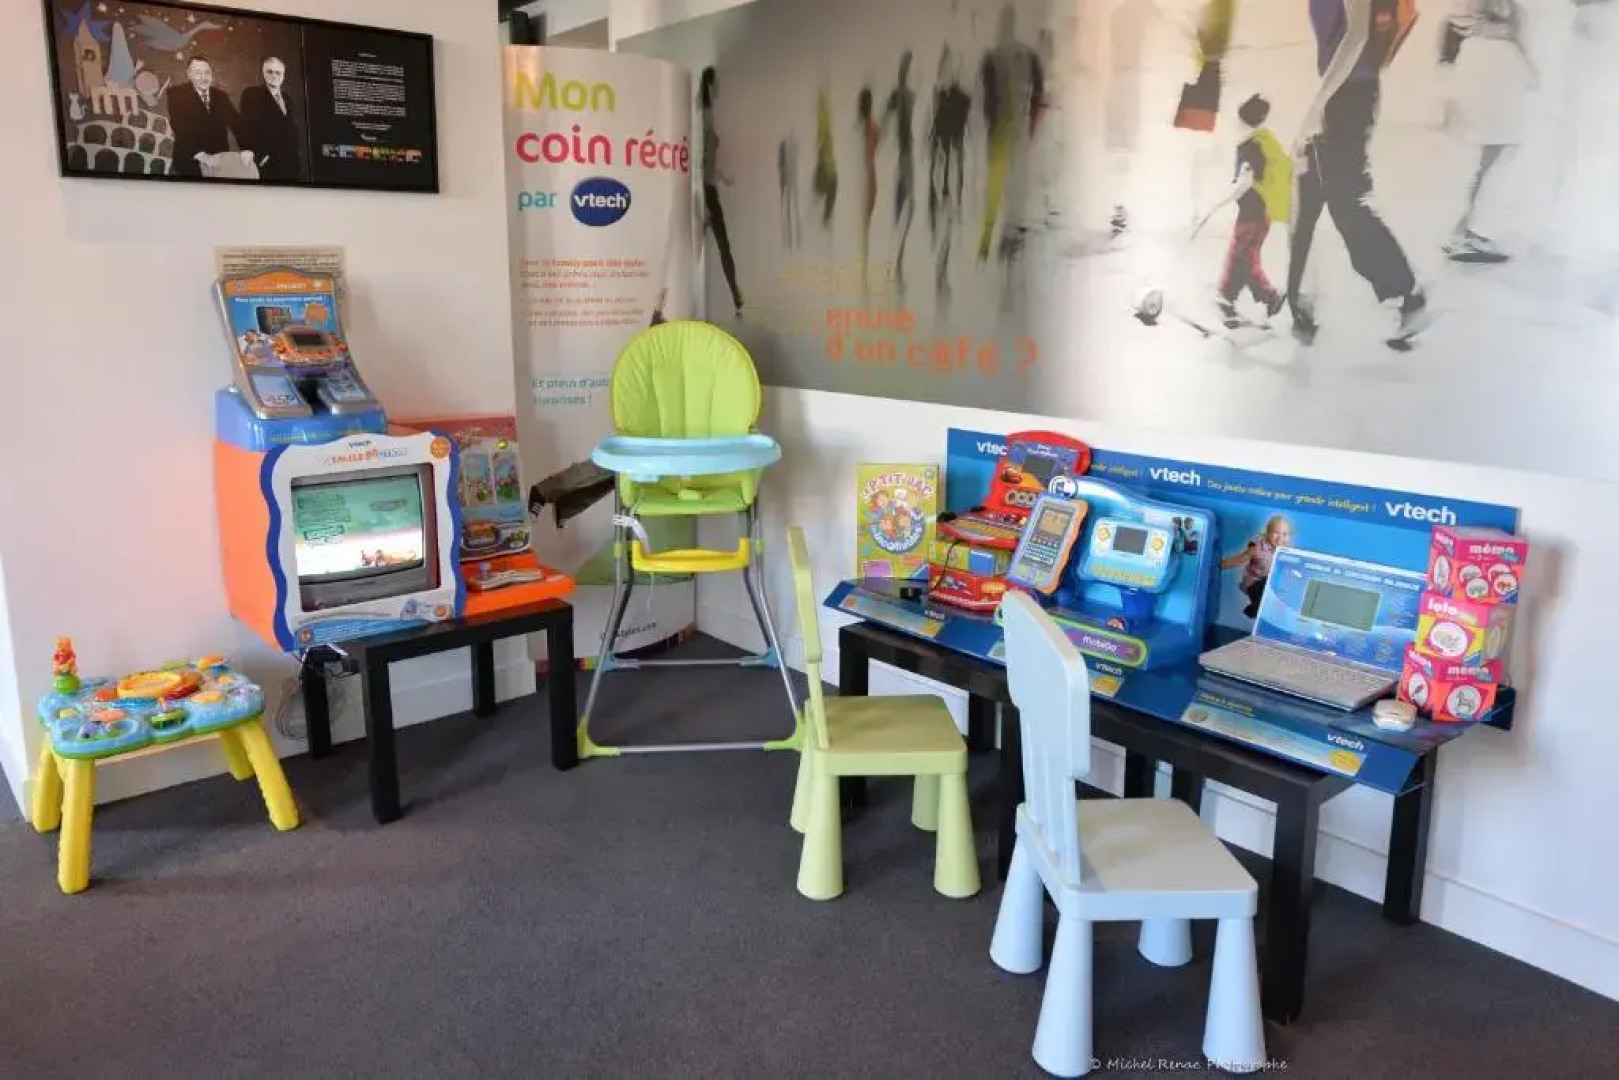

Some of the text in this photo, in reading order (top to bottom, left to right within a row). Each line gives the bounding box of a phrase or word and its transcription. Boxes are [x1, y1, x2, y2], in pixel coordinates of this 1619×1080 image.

[514, 70, 616, 114] Mon
[516, 124, 612, 165] coin
[517, 189, 630, 212] par vtech
[976, 440, 1008, 457] vtec
[1149, 466, 1201, 489] vtech
[1384, 500, 1457, 526] vtech
[1427, 597, 1459, 616] loto
[1327, 733, 1365, 752] vtech
